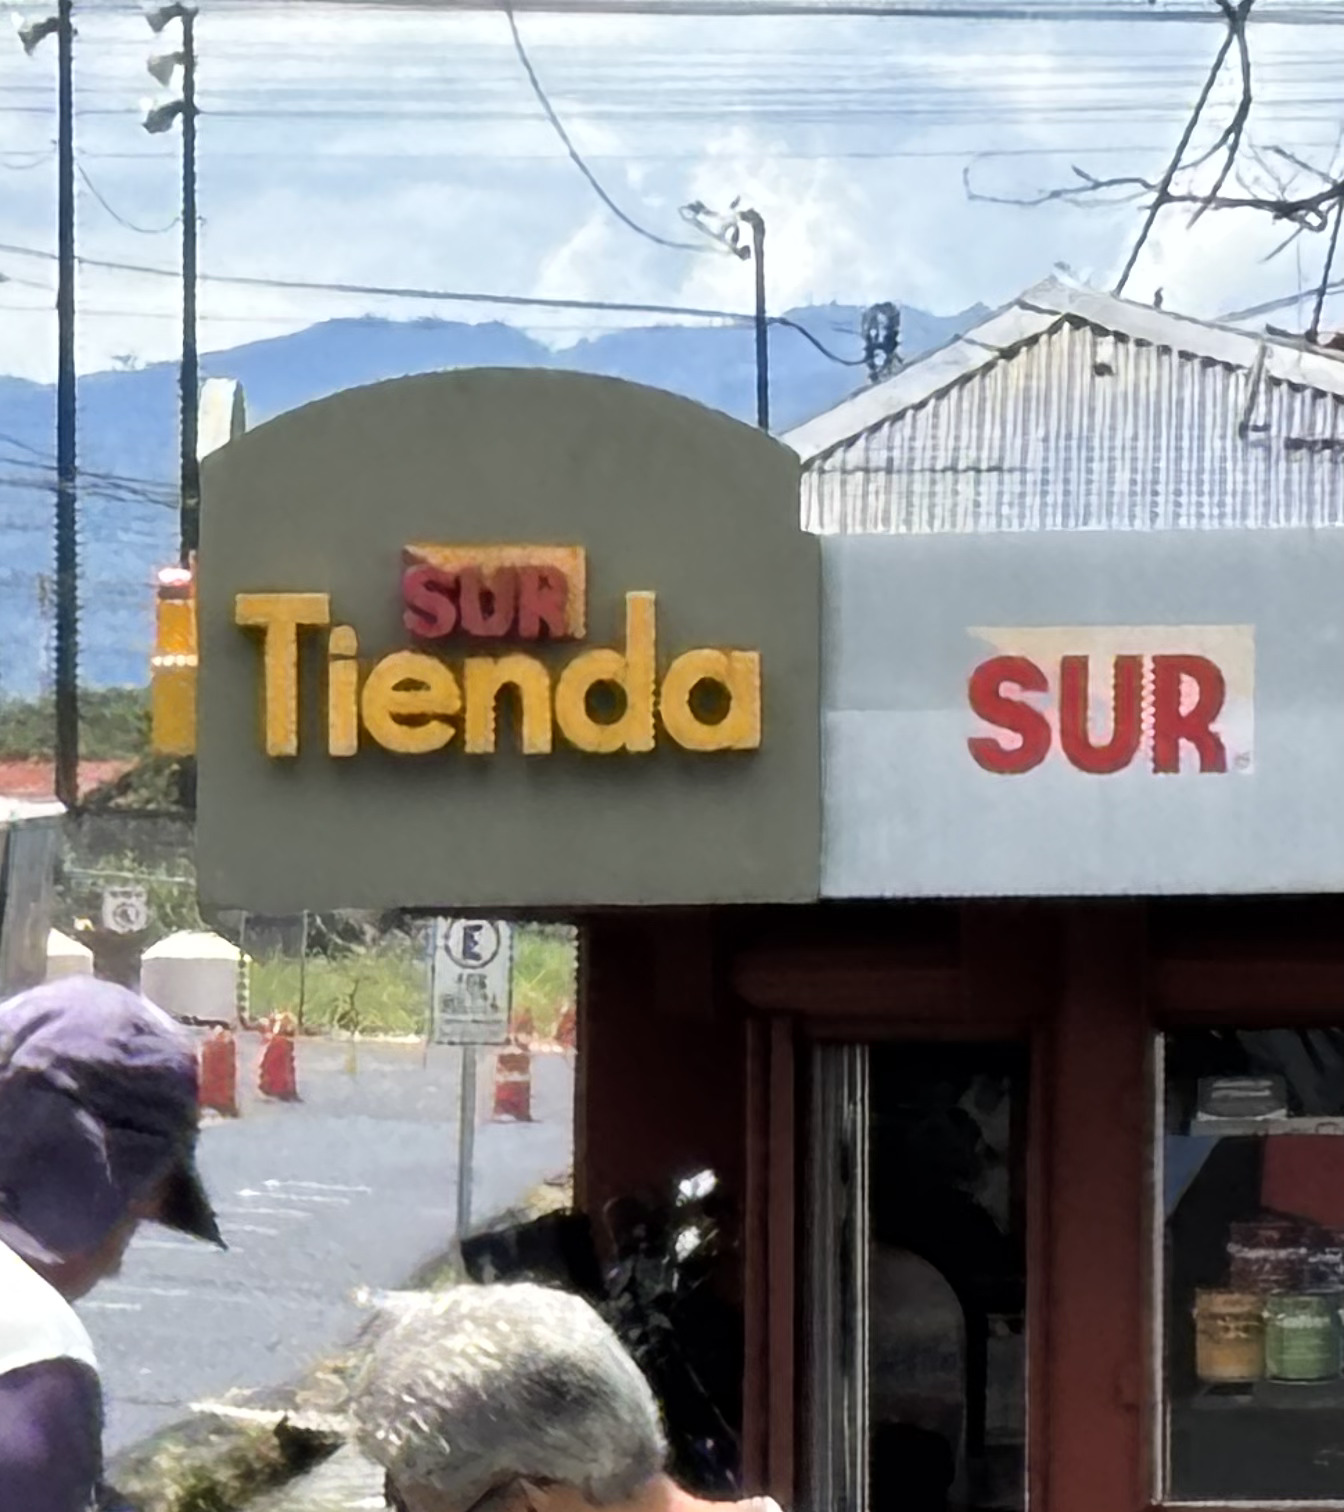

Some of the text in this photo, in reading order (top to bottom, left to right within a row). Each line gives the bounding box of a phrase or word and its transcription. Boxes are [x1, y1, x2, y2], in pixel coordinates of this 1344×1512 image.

[401, 565, 567, 637] SUR
[235, 591, 761, 756] Tienda
[968, 654, 1227, 774] SUR
